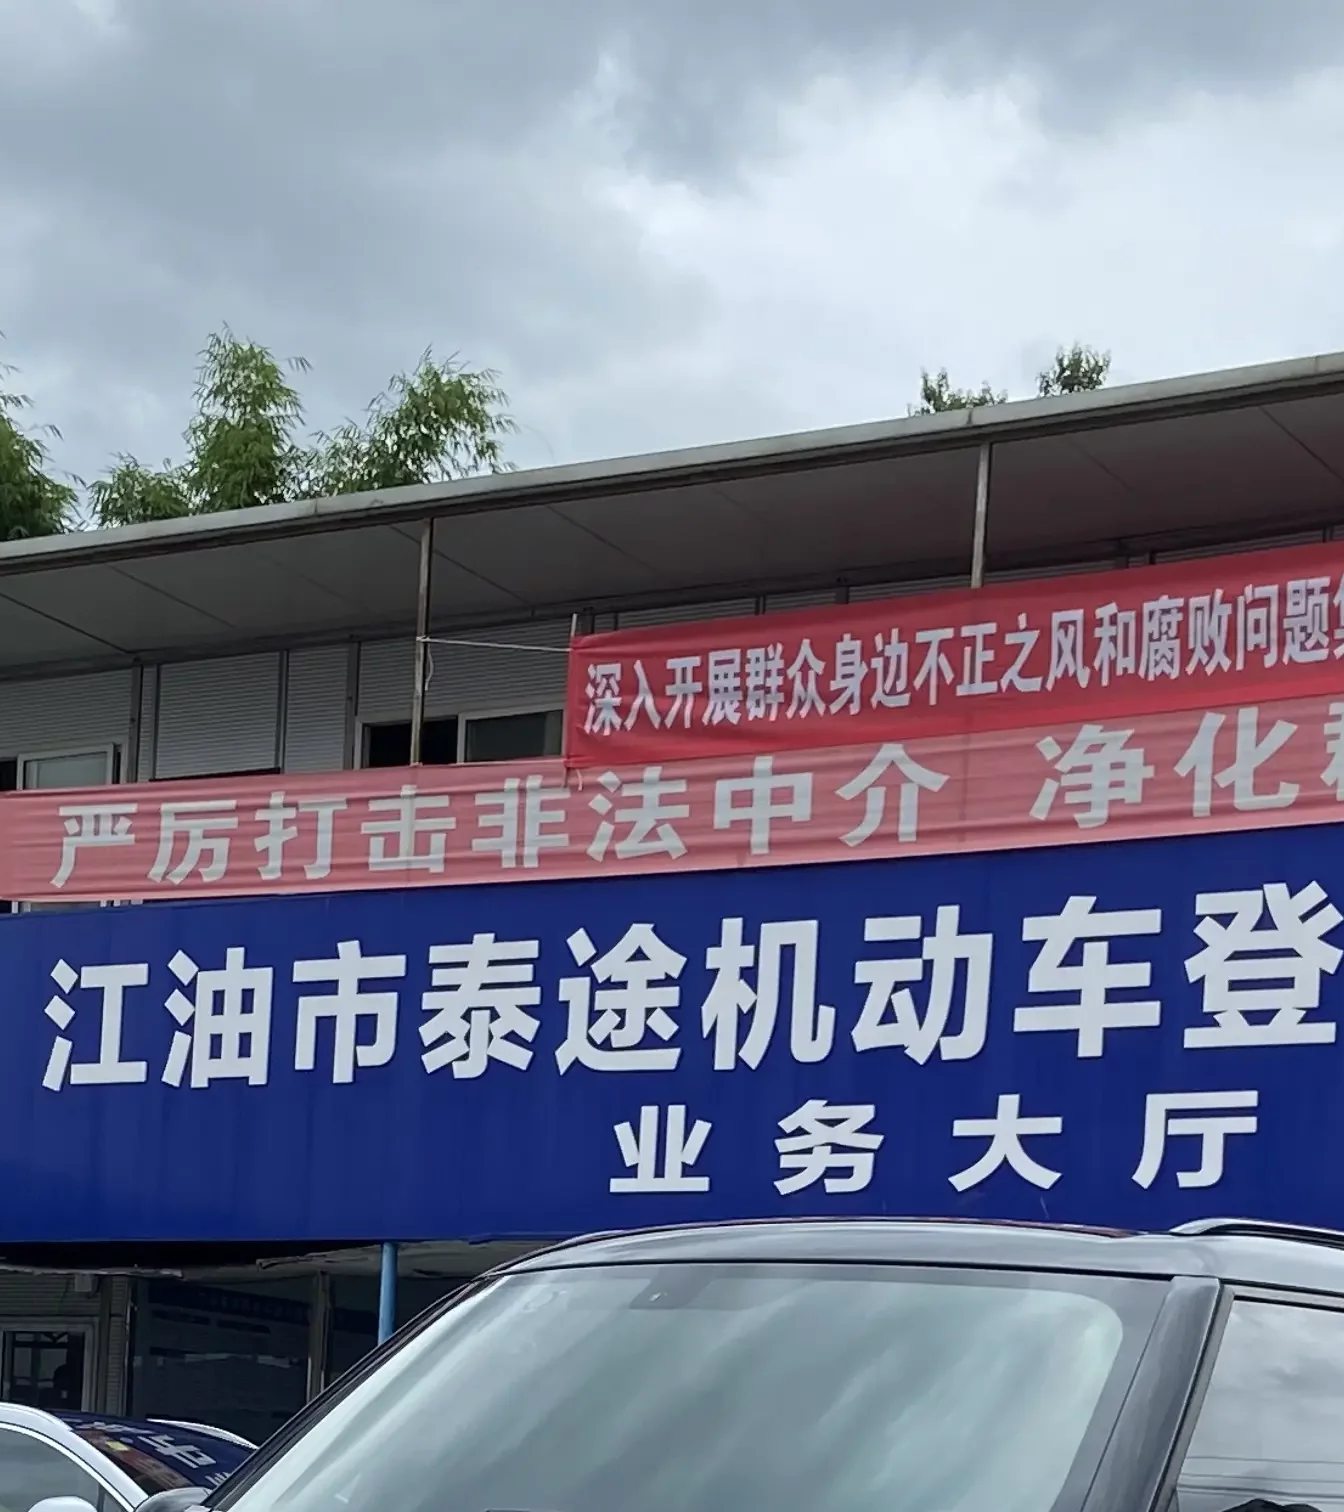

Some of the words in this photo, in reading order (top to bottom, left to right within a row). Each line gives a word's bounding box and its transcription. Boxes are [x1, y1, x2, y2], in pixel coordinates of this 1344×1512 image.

[49, 741, 951, 890] 严厉打击非法中介
[608, 1088, 1260, 1198] 业务大厅
